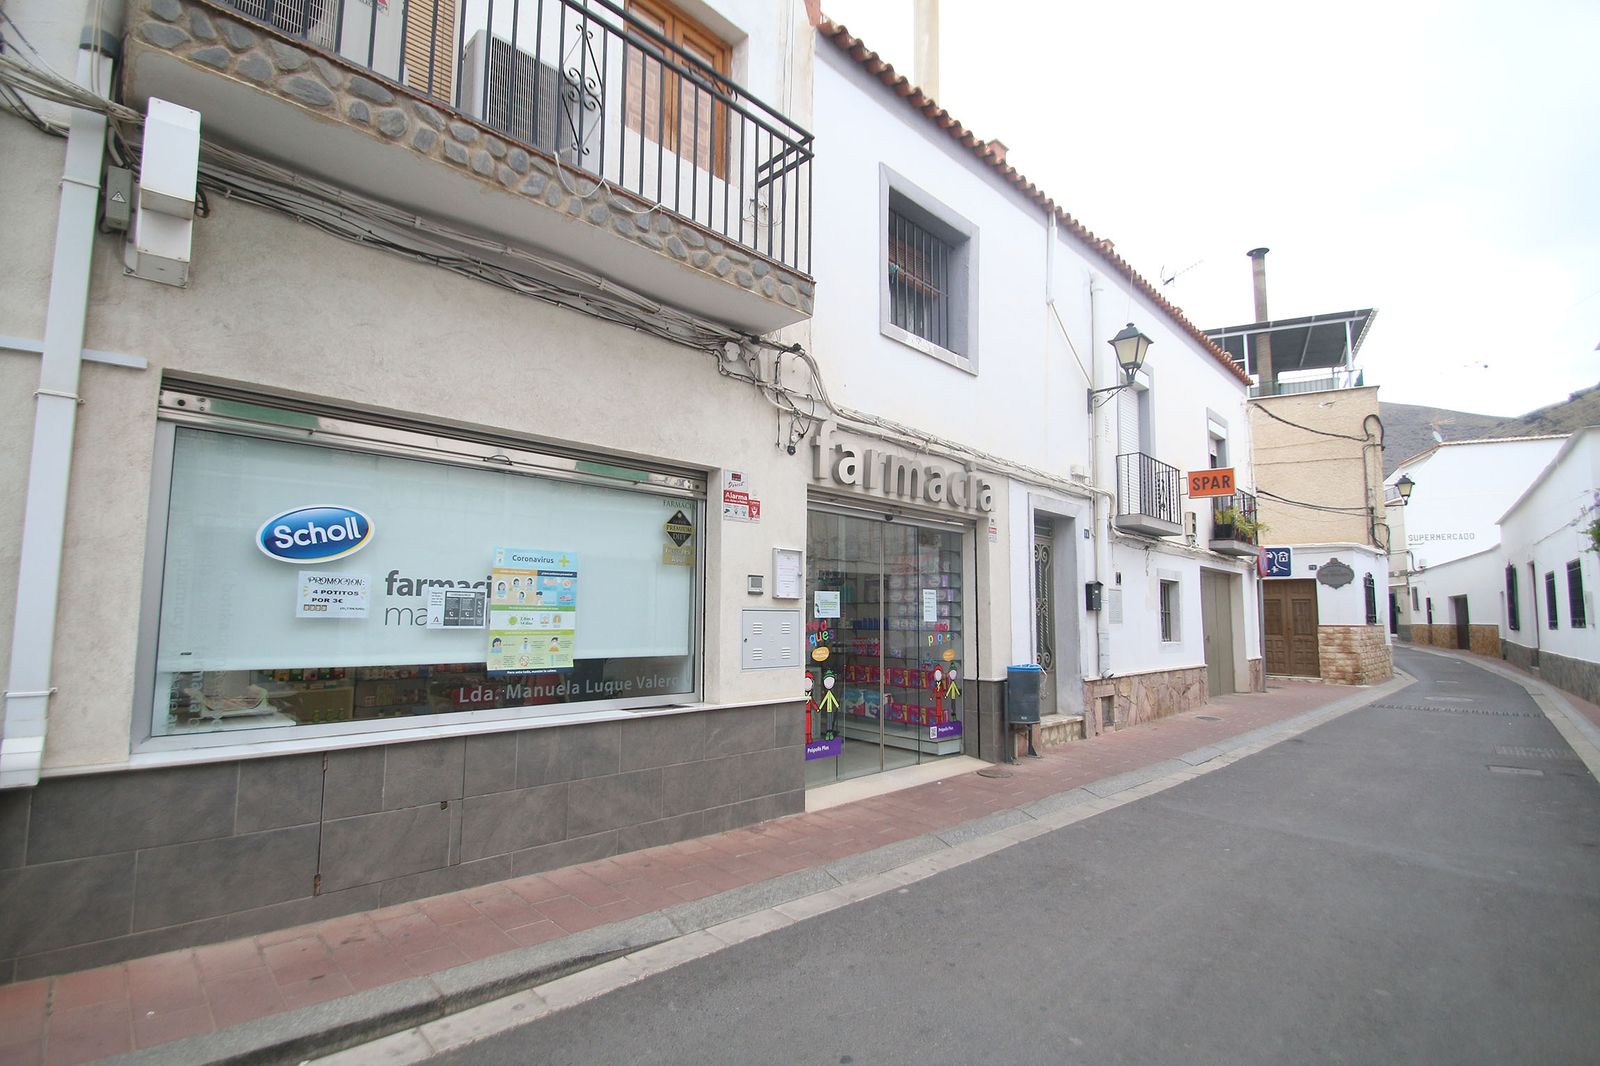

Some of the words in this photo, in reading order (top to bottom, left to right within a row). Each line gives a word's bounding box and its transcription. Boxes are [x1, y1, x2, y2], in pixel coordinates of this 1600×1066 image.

[810, 419, 994, 512] farmacia
[1193, 475, 1231, 491] SPAR
[725, 492, 748, 501] Alarma
[273, 516, 362, 549] Scholl
[1407, 532, 1476, 542] SUPERMERCADO
[512, 554, 555, 564] Coronavirus
[320, 589, 360, 597] POTITOS
[459, 685, 499, 703] Lda.
[506, 680, 580, 700] Manuela
[585, 679, 633, 694] Luque
